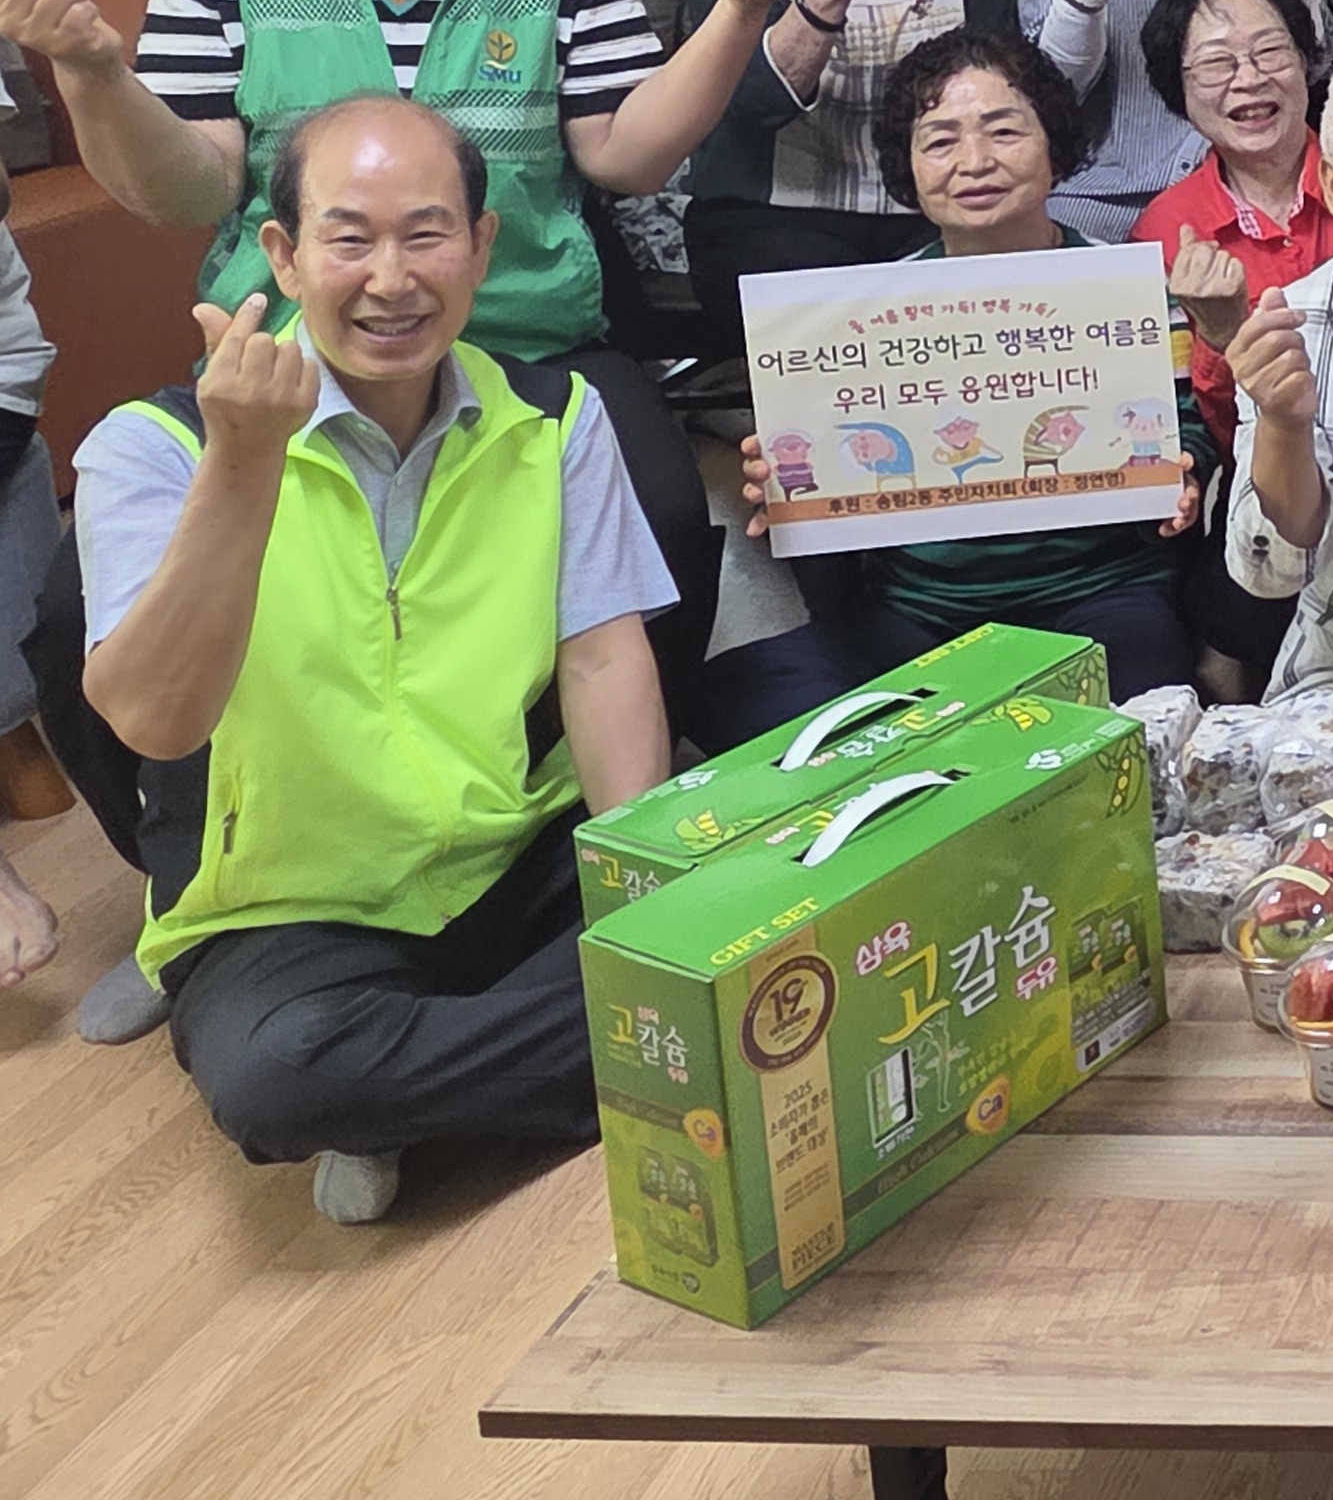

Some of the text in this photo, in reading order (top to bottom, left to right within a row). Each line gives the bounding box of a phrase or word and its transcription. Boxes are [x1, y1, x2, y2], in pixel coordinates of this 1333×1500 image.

[869, 309, 900, 326] 여름
[904, 304, 934, 321] 활력
[940, 300, 977, 315] 가득!
[757, 316, 1162, 377] 어르신의 건강하고 행복한 여름을
[833, 367, 1099, 414] 우리 모두 응원합니다!
[828, 497, 861, 514] 후원
[875, 488, 934, 510] 송림2동
[938, 482, 1017, 504] 주민자치회
[709, 896, 823, 967] GIFT SET
[855, 921, 912, 976] 삼육
[878, 885, 1056, 1044] 고칼슘
[1014, 956, 1060, 1000] 두유
[769, 978, 810, 1023] 19
[606, 1003, 689, 1068] 고칼슘
[783, 1080, 813, 1109] 2025
[978, 1094, 1003, 1122] Ca
